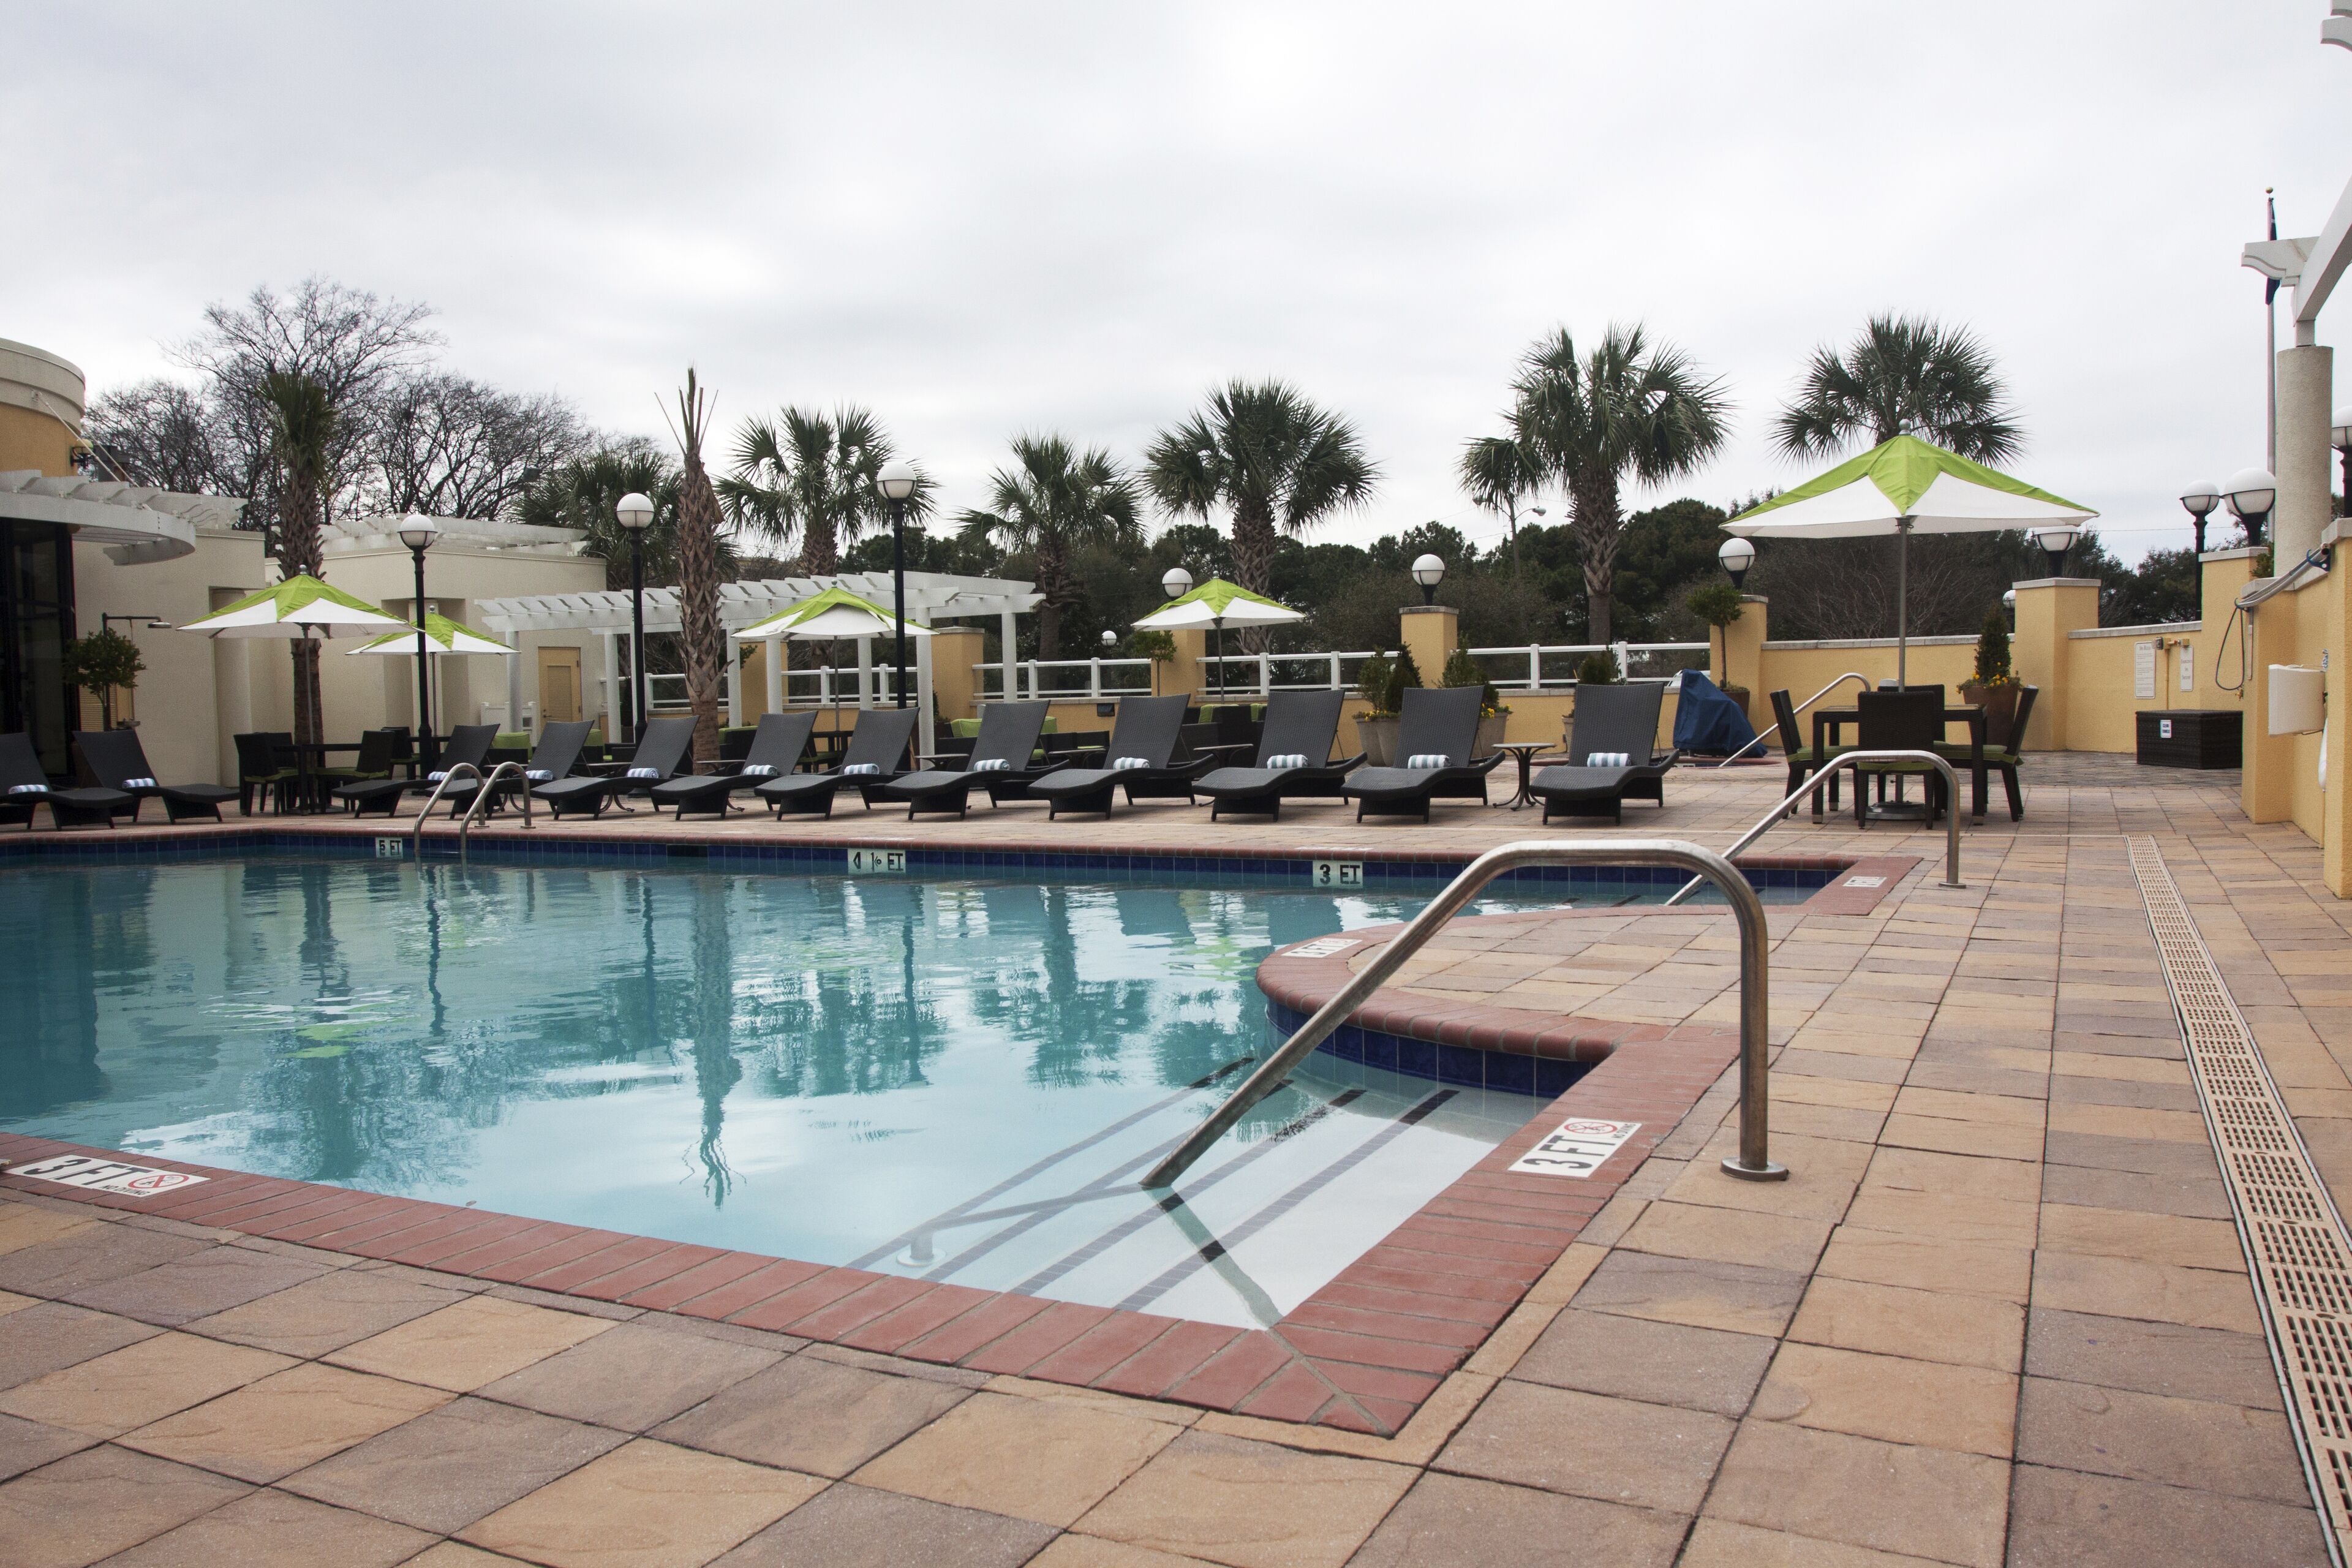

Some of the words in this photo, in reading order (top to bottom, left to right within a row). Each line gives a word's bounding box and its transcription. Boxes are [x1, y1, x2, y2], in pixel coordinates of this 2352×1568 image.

[379, 840, 385, 853] 5
[390, 840, 401, 853] FT
[888, 853, 903, 867] FT
[1320, 864, 1330, 881] 3
[1340, 865, 1360, 881] FT
[1538, 1135, 1616, 1156] FT
[23, 1158, 91, 1175] 3
[1523, 1158, 1593, 1169] 3
[54, 1164, 153, 1185] FT
